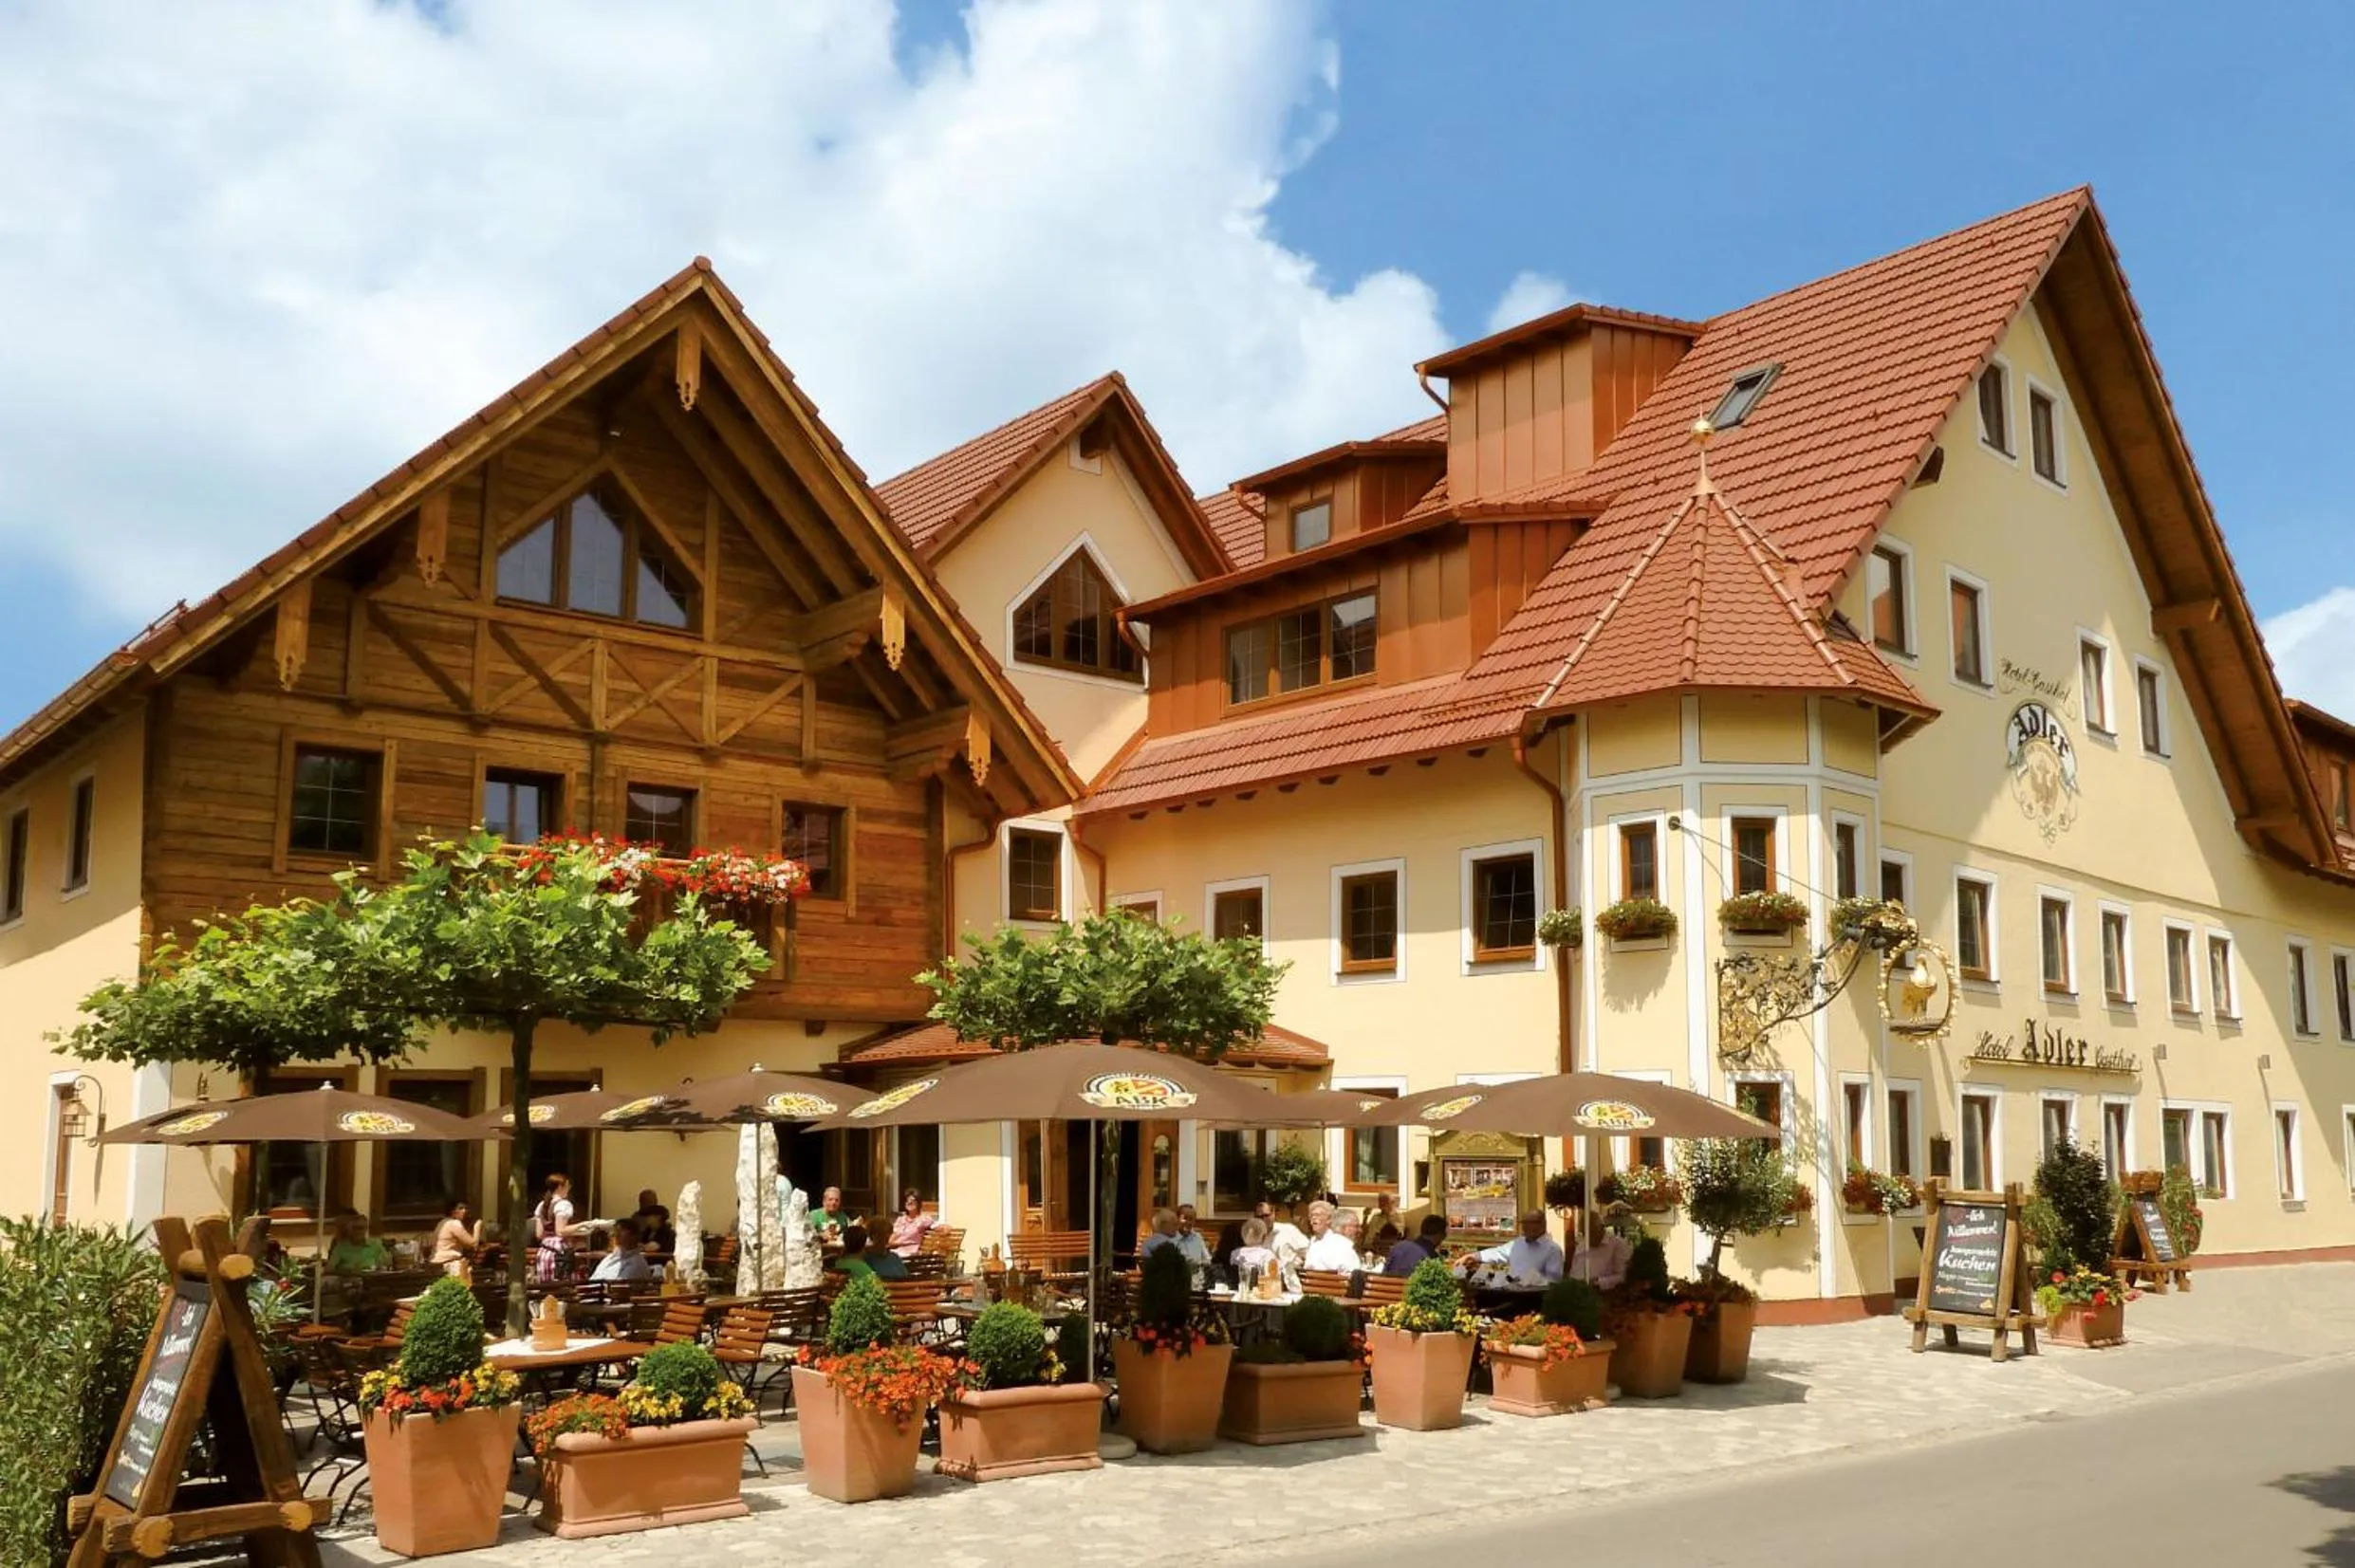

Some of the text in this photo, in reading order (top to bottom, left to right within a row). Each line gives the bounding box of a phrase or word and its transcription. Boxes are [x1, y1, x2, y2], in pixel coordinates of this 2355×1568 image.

[1974, 1030, 2014, 1059] Hotel
[2022, 1018, 2087, 1065] Adler
[1938, 1248, 1996, 1271] Kuchen
